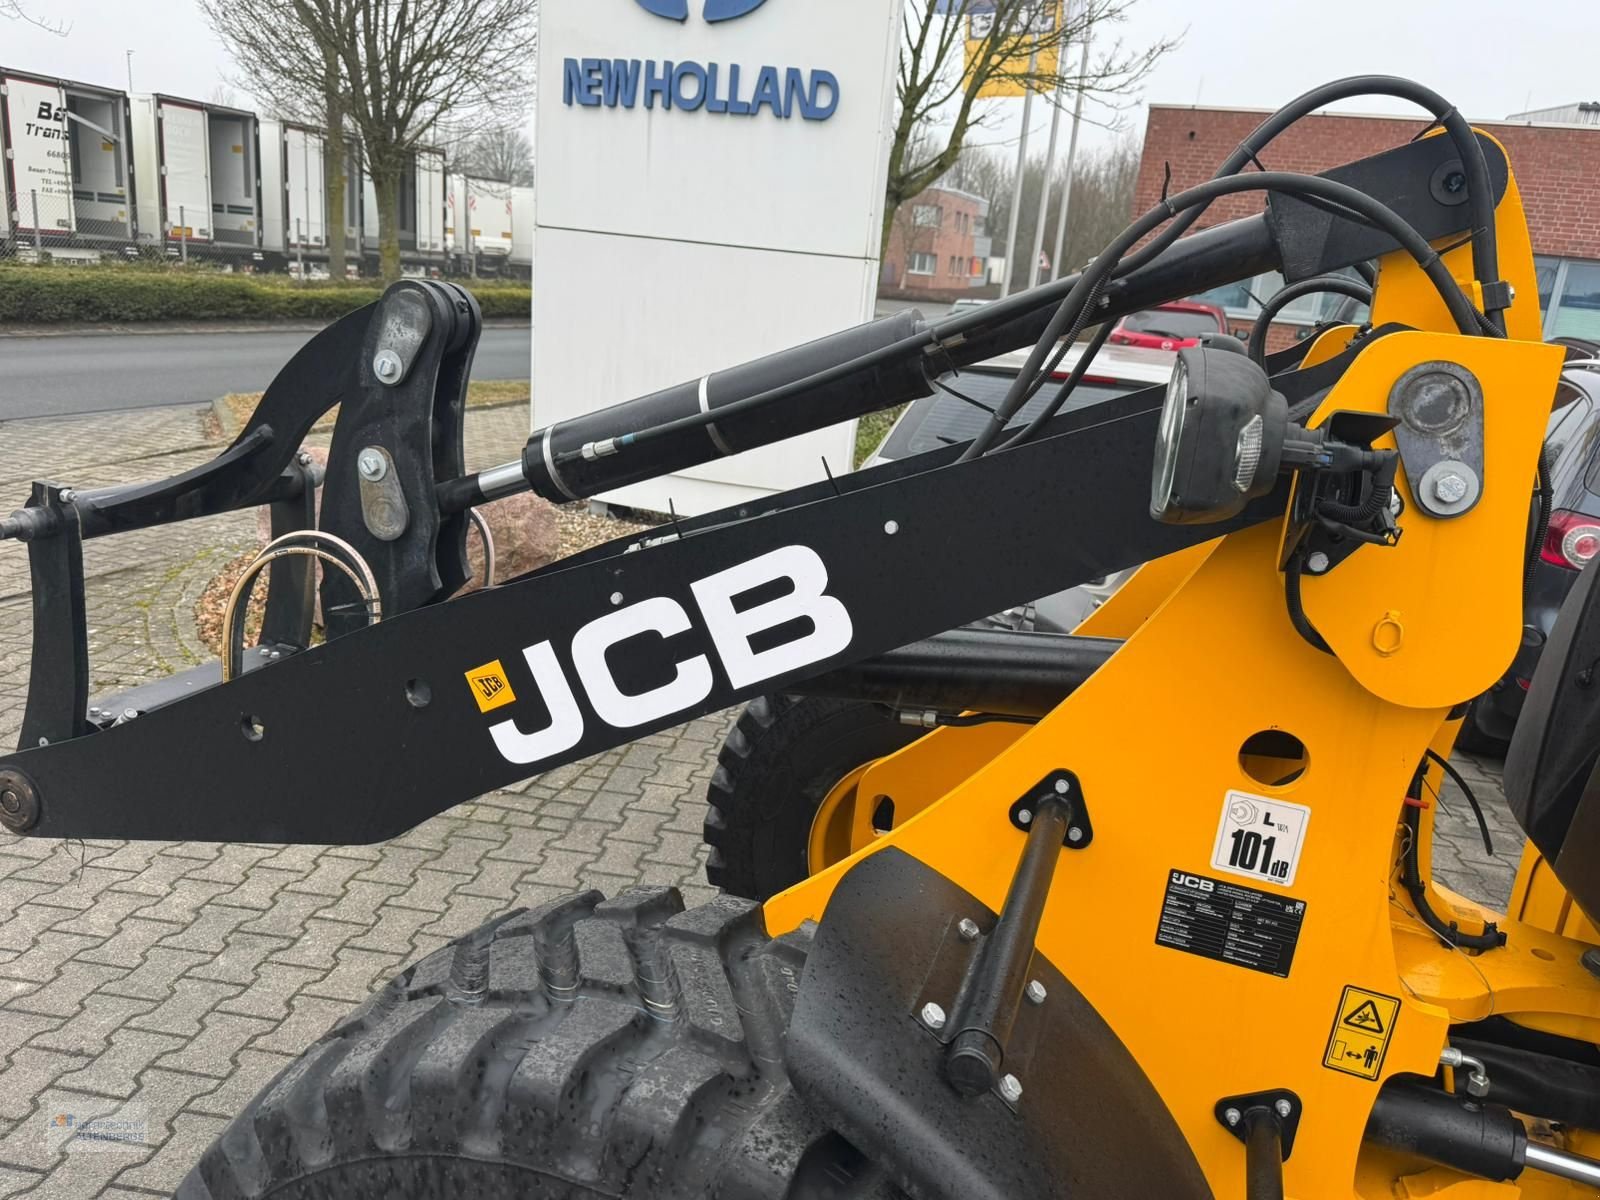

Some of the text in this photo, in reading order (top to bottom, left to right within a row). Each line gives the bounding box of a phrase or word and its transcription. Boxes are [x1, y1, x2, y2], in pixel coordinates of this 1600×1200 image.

[563, 57, 840, 121] NEW HOLLAND
[488, 544, 854, 764] JCB
[478, 676, 503, 697] JCB
[1263, 811, 1275, 827] L
[1228, 828, 1289, 878] 101 dB
[1172, 872, 1215, 892] JCB
